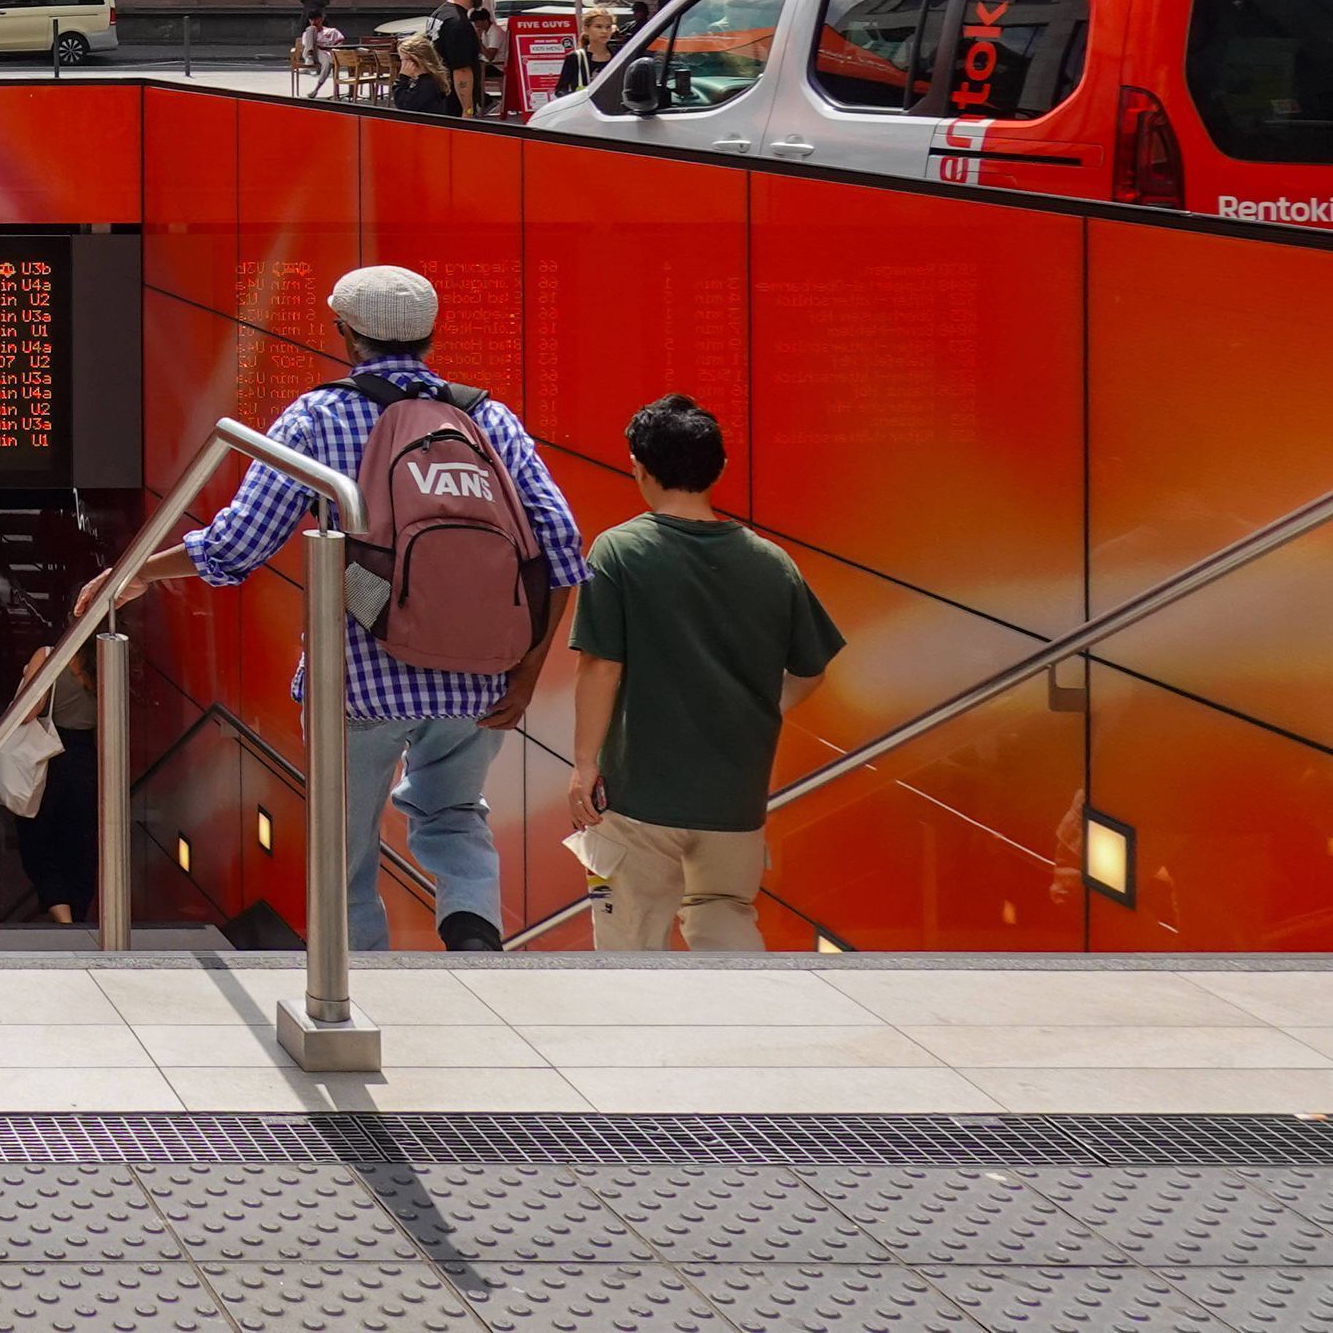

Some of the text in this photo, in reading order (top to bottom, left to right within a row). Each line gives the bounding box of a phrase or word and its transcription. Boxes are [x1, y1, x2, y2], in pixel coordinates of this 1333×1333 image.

[517, 20, 570, 29] FIVE GUYS
[21, 262, 51, 274] U3b
[21, 278, 51, 291] U4a
[30, 293, 50, 306] U2
[21, 310, 52, 322] U3a
[31, 324, 49, 337] U1
[21, 340, 52, 353] U4a
[30, 355, 50, 368] U2
[21, 372, 52, 384] U3a
[21, 386, 52, 399] U4a
[407, 462, 494, 502] VANS
